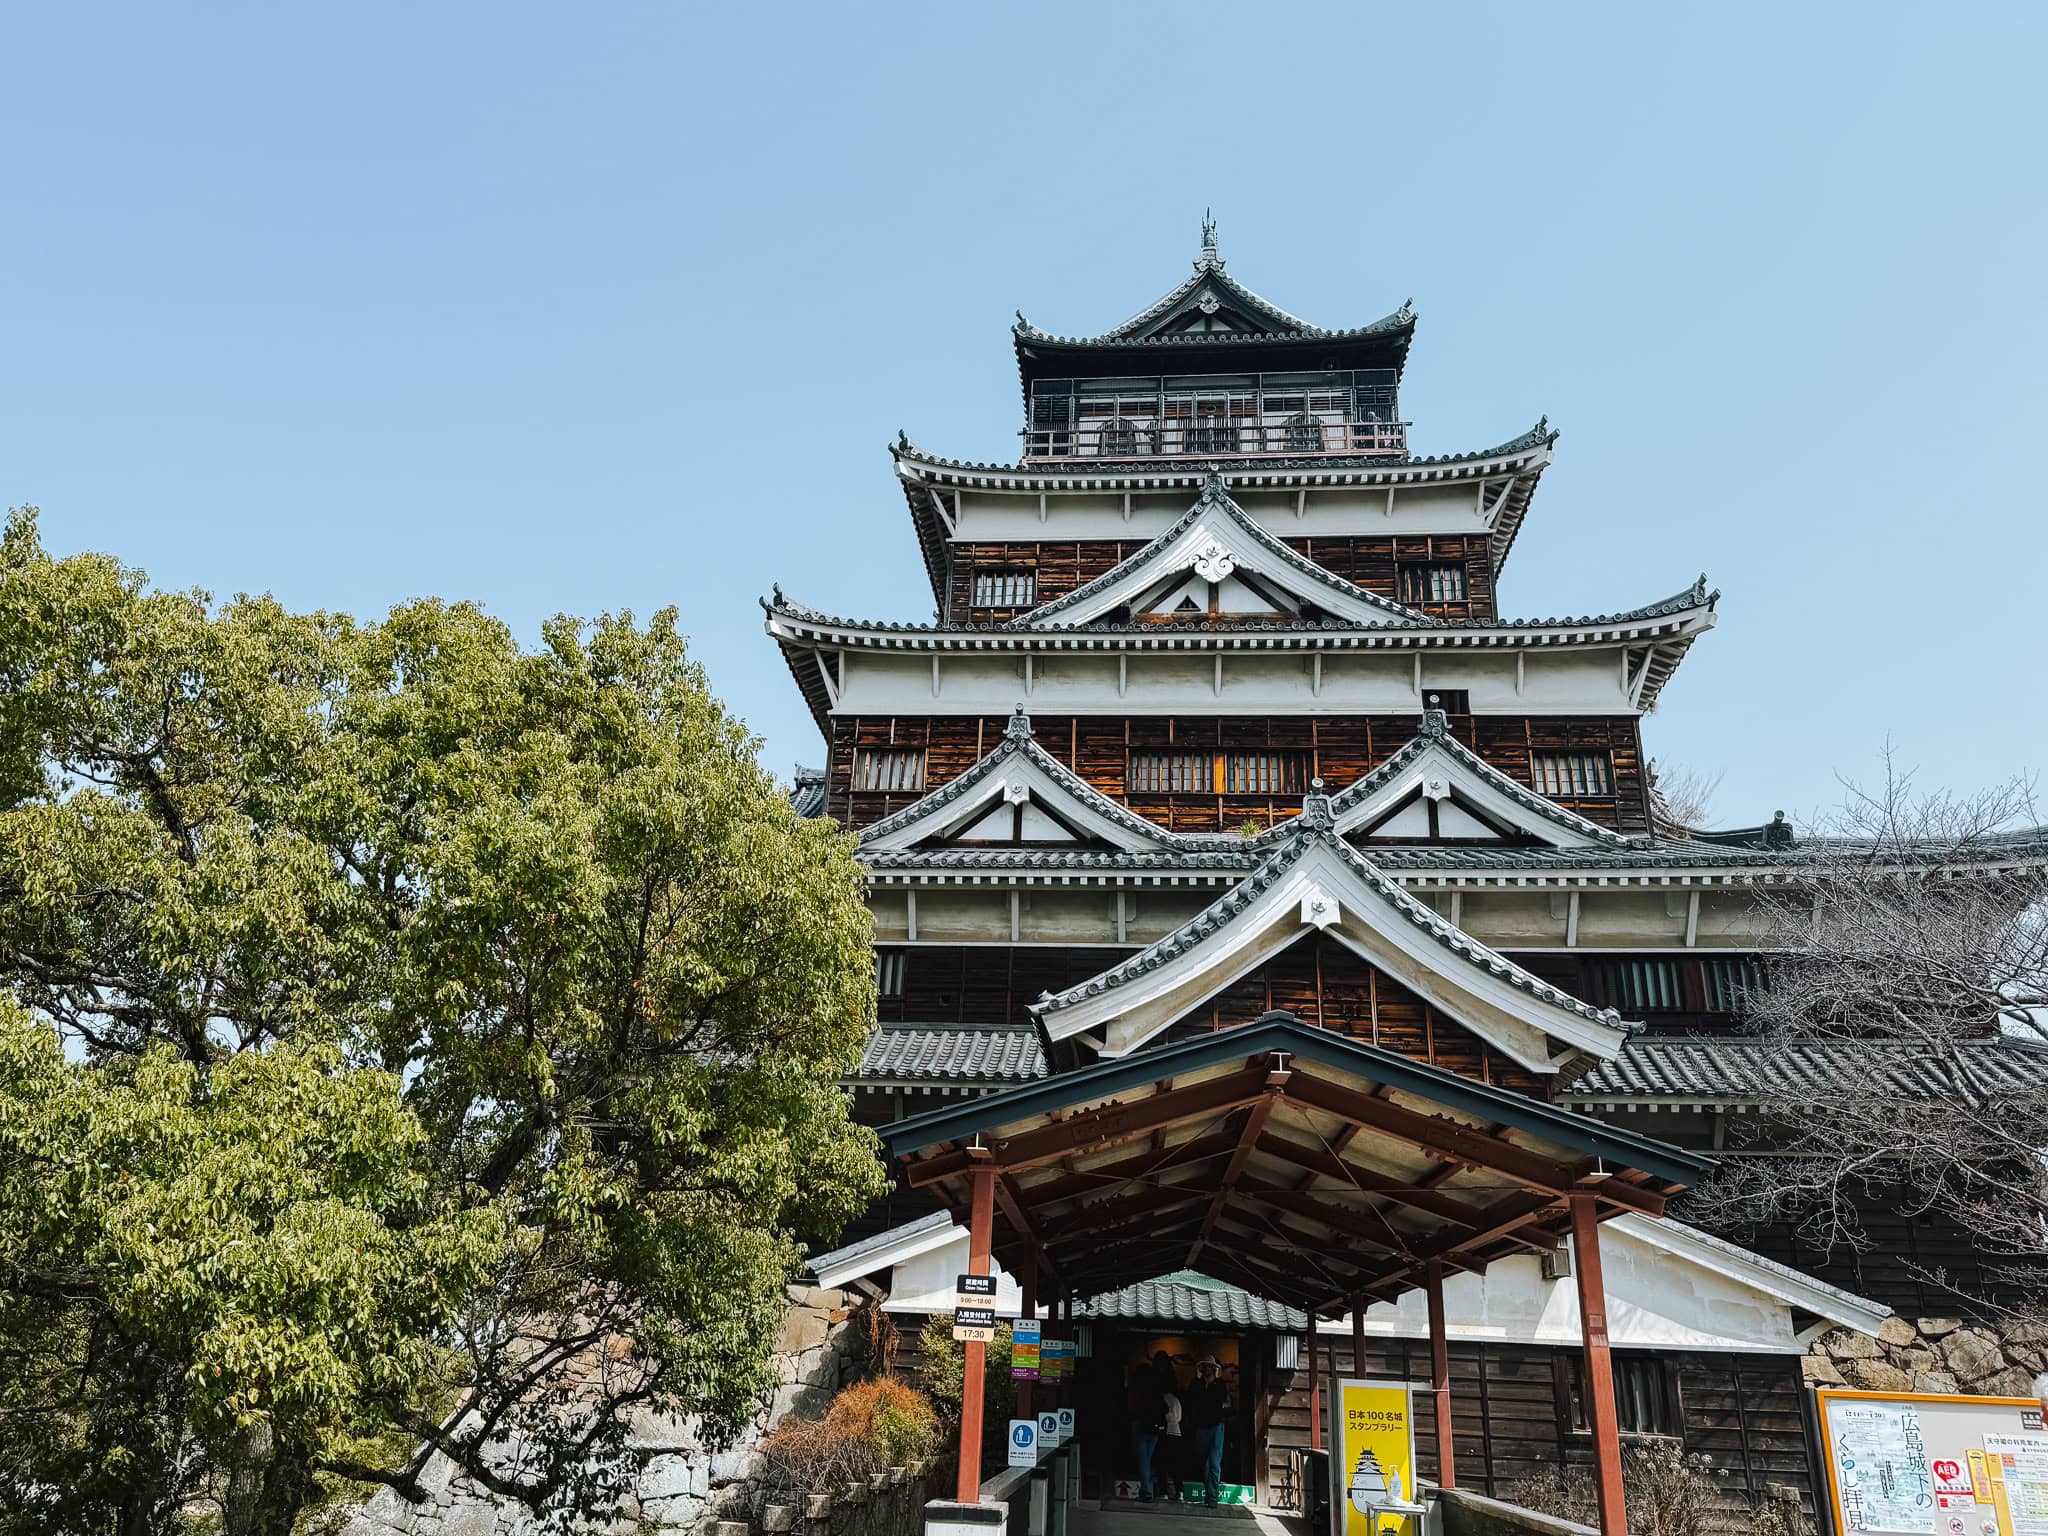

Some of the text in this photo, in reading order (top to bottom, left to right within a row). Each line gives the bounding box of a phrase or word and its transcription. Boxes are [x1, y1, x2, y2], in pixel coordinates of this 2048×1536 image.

[963, 1329, 985, 1339] 17:30
[1349, 1422, 1403, 1432] スタンプラリー
[1901, 1412, 1933, 1509] 広島城下の
[1937, 1463, 1957, 1475] AED
[1839, 1433, 1868, 1531] くらし拝見
